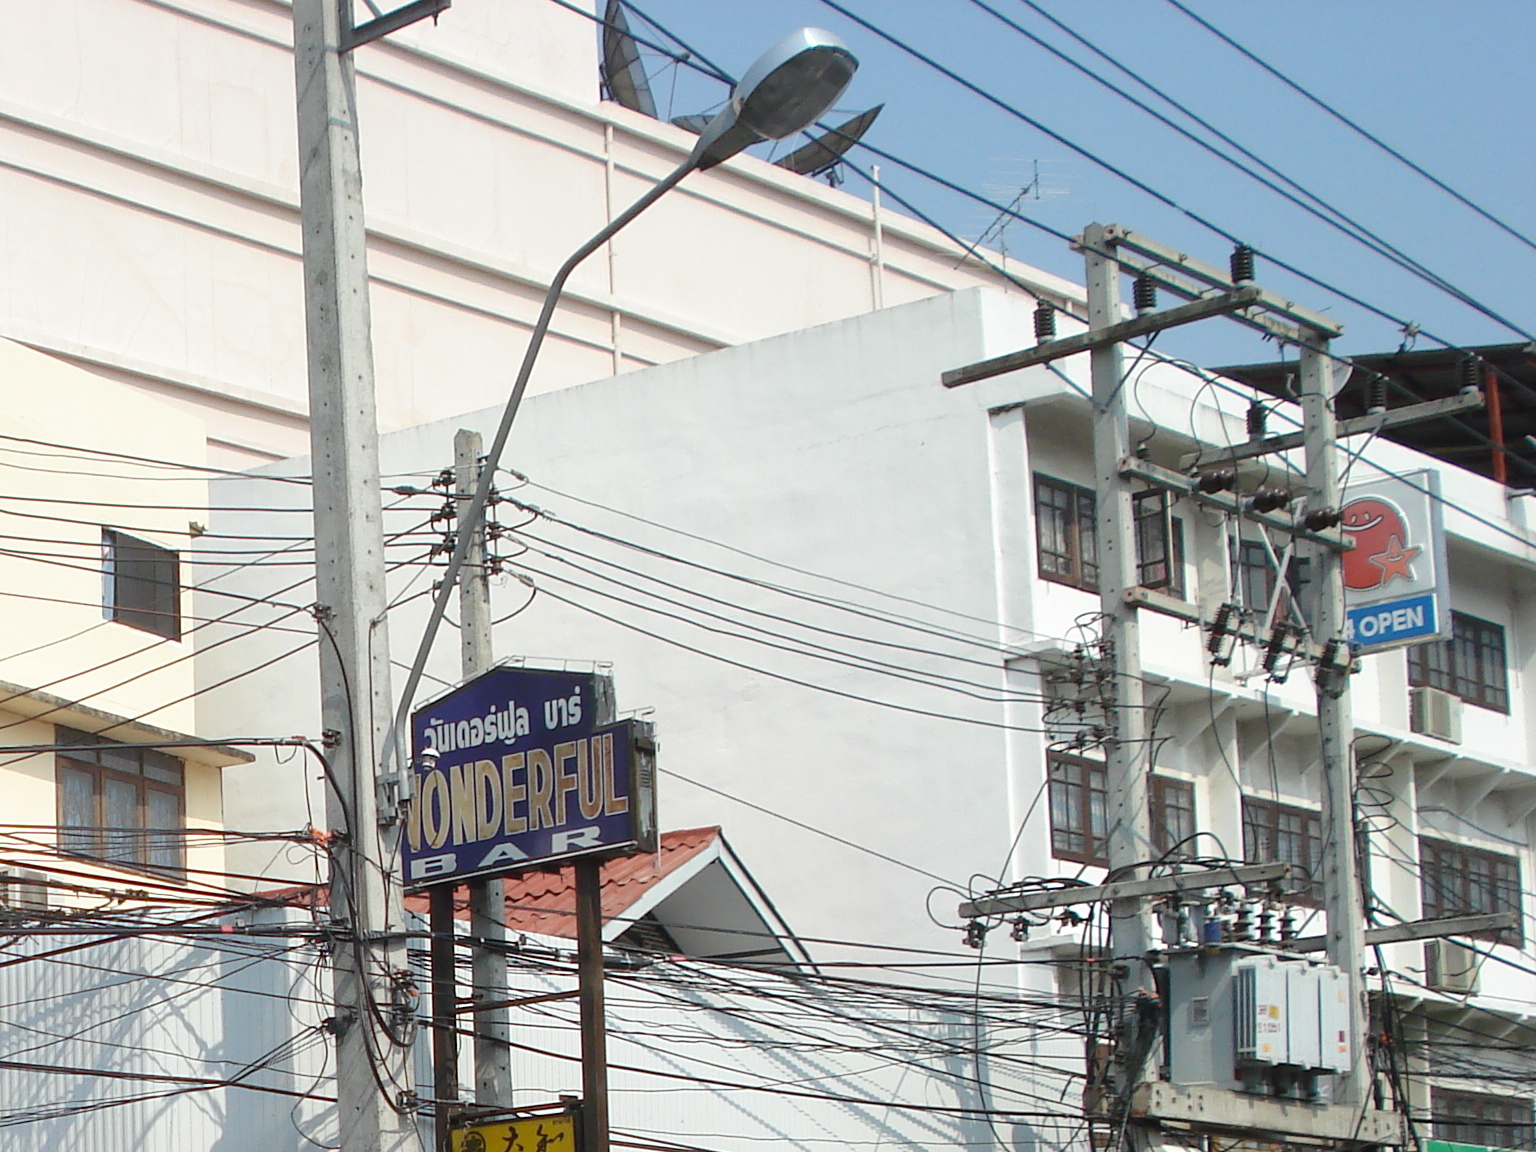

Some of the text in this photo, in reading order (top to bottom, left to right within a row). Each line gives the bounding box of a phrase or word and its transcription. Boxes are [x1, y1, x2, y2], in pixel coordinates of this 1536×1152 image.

[1359, 605, 1425, 637] OPEN
[544, 686, 583, 730] บาร์
[409, 825, 603, 880] BAR
